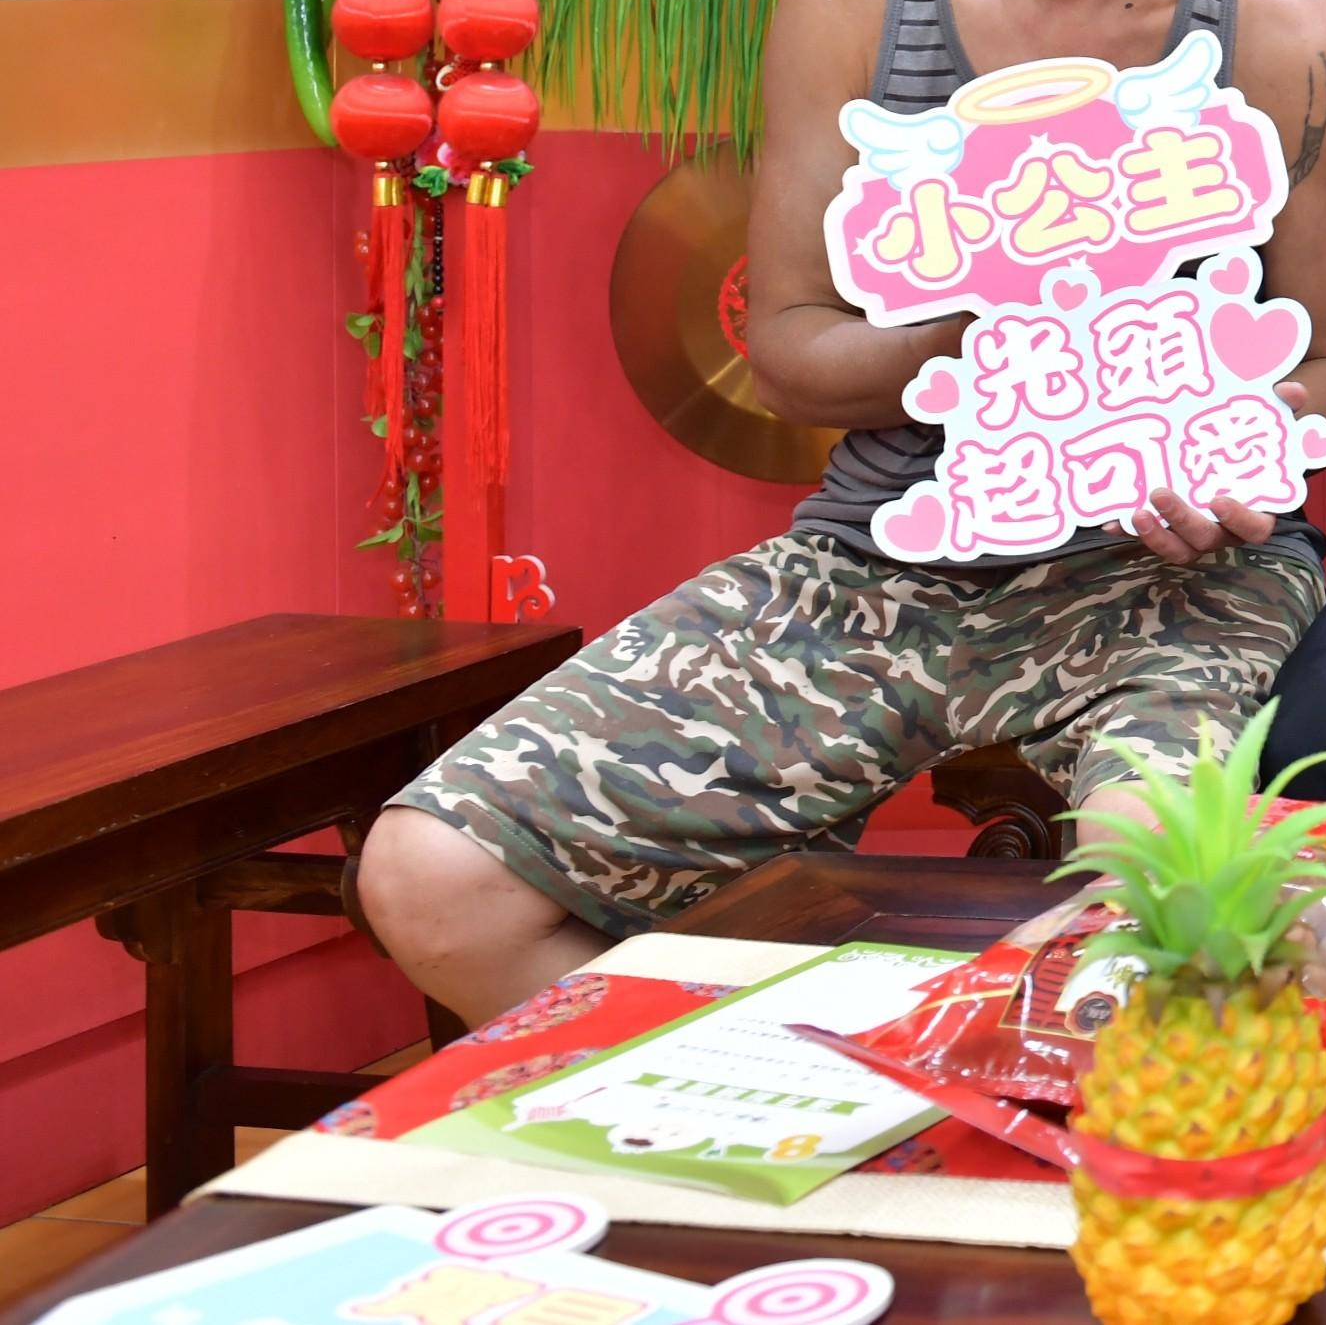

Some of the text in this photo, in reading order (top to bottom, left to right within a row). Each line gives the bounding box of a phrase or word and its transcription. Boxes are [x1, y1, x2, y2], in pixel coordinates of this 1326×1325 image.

[873, 127, 1246, 282] 小公主
[973, 290, 1215, 431] 光頭
[947, 394, 1299, 553] 超可愛
